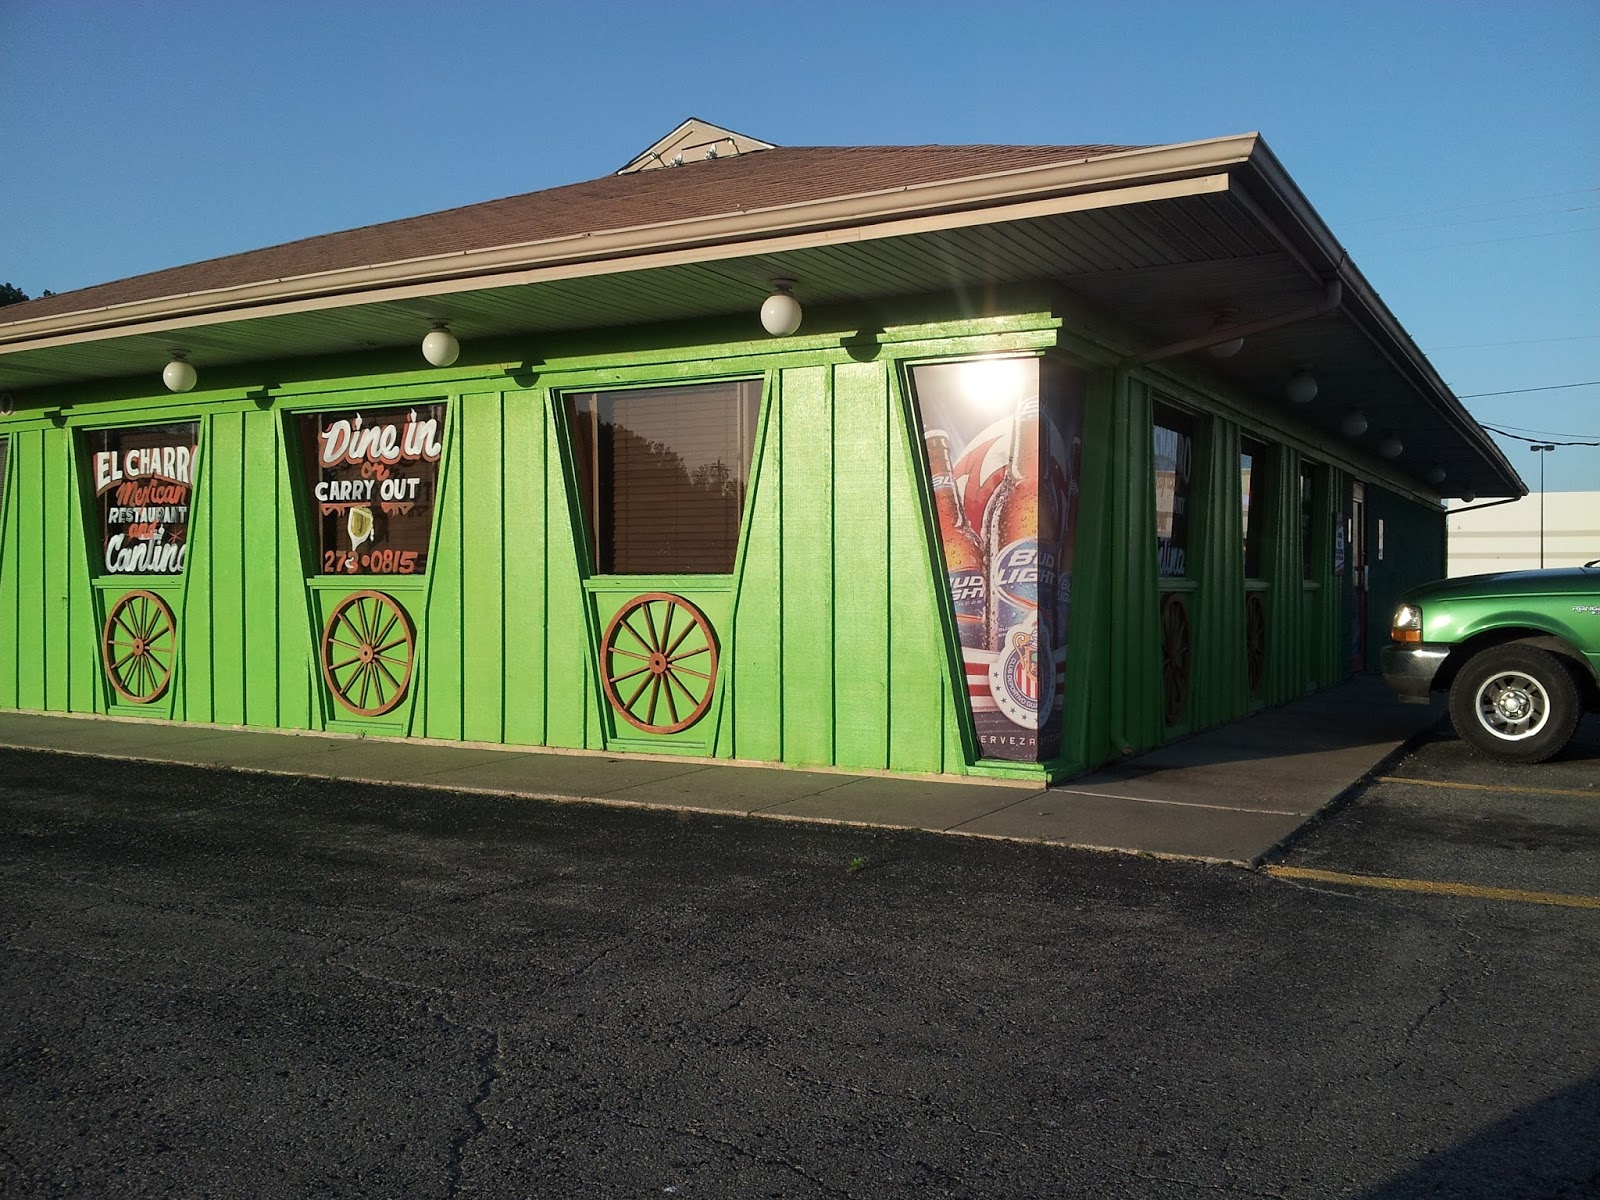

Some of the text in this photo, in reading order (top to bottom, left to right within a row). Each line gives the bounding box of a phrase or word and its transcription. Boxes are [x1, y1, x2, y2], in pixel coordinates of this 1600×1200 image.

[319, 408, 442, 468] Dine in
[94, 450, 123, 495] EL
[361, 462, 390, 481] or
[116, 480, 187, 508] Mexican
[315, 478, 420, 501] CARRY OUT
[128, 519, 158, 538] and
[1008, 549, 1055, 568] BUD
[999, 566, 1056, 586] LIGHT
[952, 587, 985, 602] GHT
[1006, 658, 1016, 674] CLUB
[1007, 674, 1027, 705] DEPORTIVO
[980, 735, 1037, 747] ERVEZA
